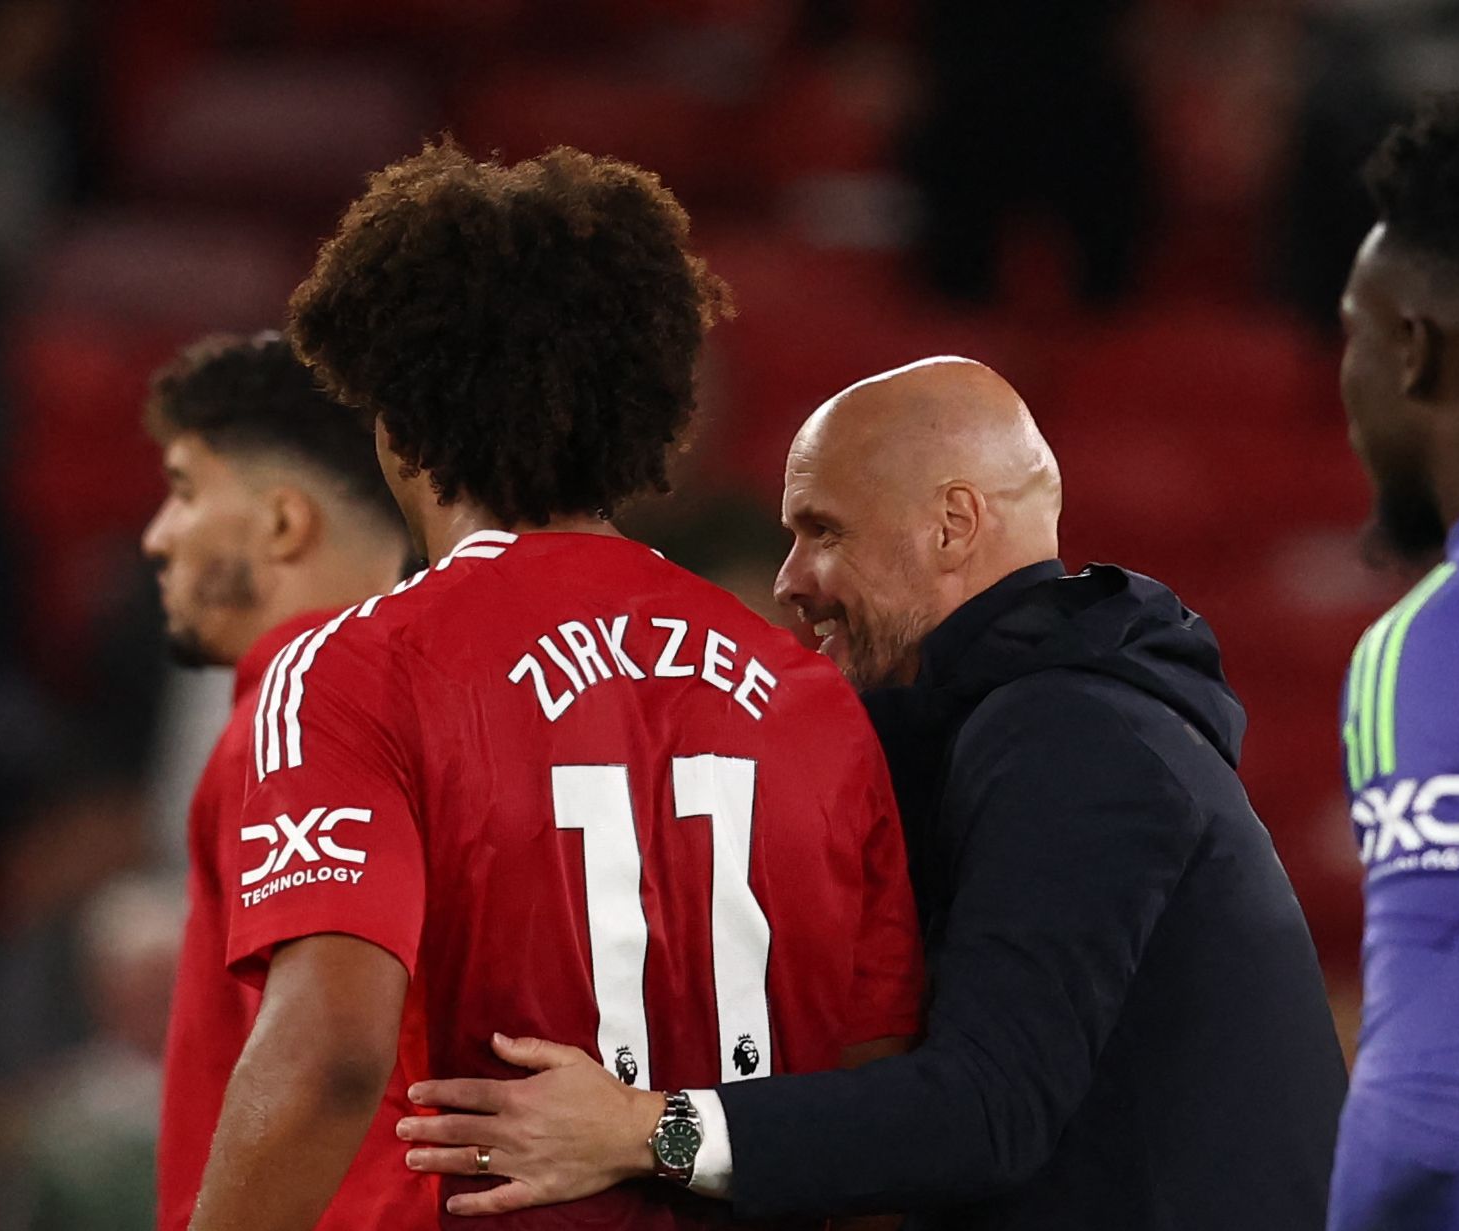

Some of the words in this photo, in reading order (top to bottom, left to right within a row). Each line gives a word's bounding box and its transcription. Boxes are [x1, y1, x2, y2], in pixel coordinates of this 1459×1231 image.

[507, 615, 777, 722] ZIRKZEE
[240, 806, 372, 887] DXC
[241, 866, 363, 908] TECHNOLOGY
[551, 752, 773, 1090] 11
